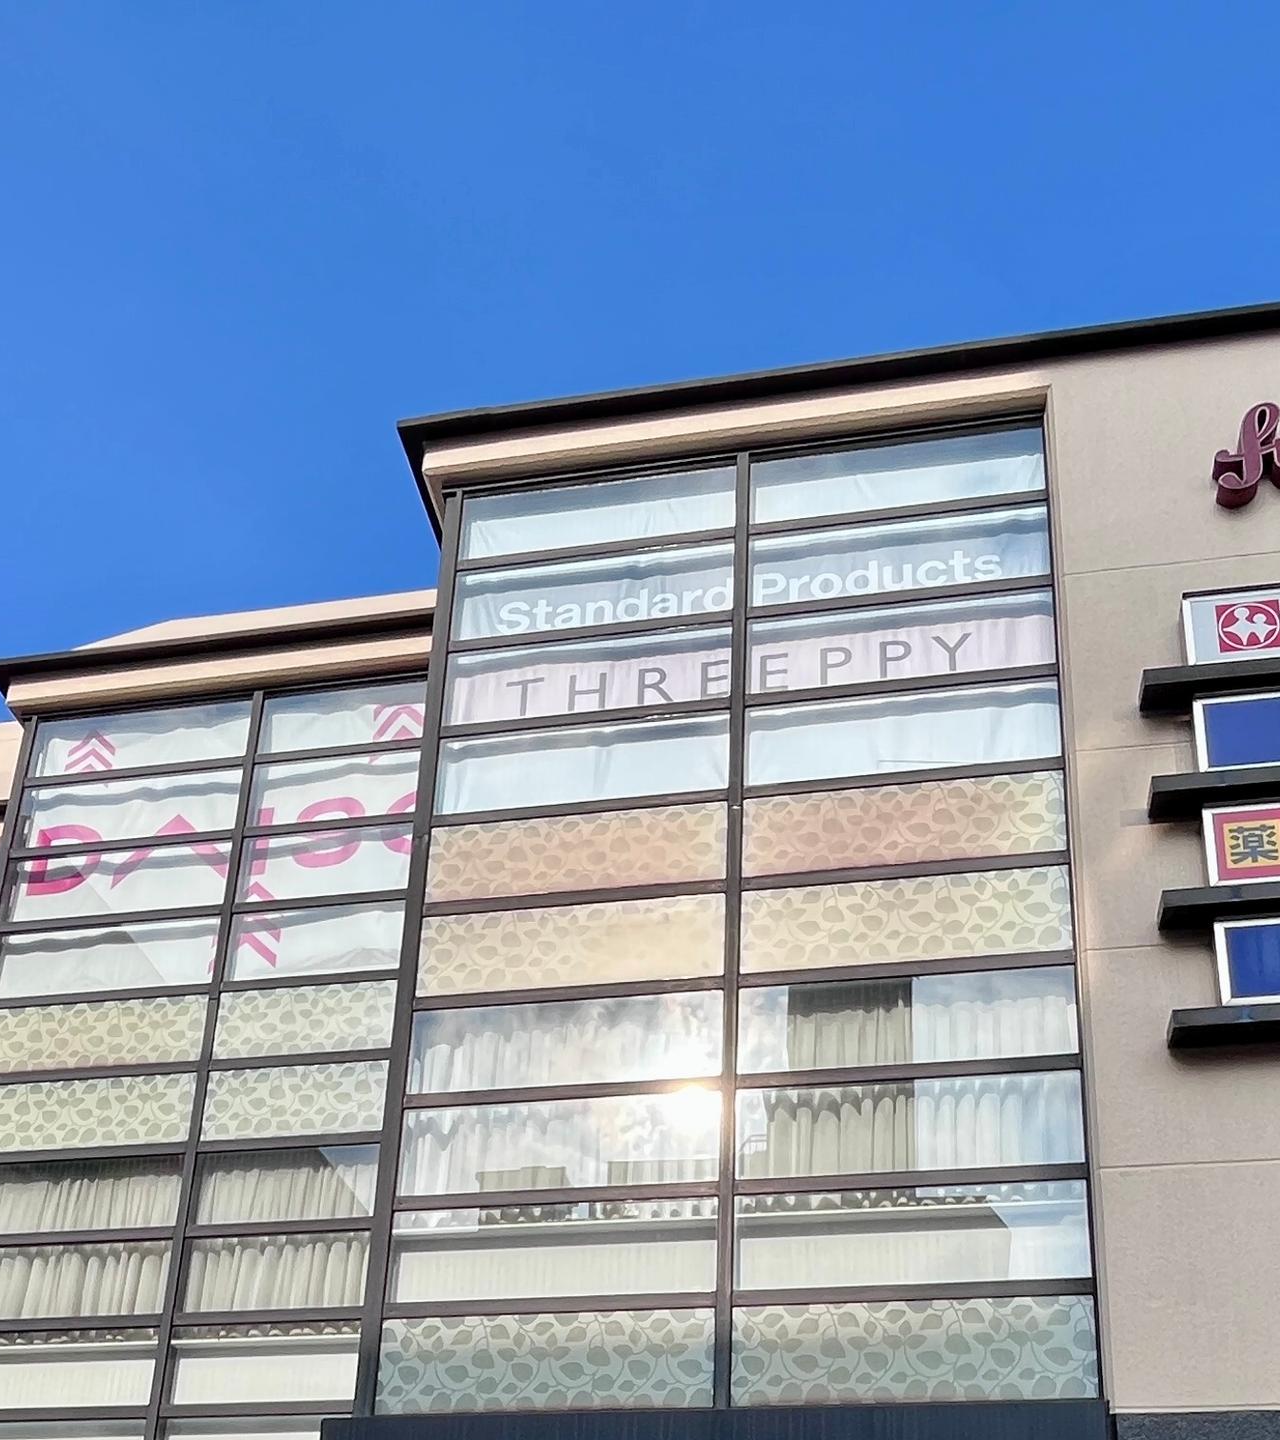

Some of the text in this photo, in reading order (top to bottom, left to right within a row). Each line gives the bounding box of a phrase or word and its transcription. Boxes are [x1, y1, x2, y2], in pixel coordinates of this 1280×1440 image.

[496, 548, 1004, 636] Standard Products
[507, 632, 972, 717] THREEPPY
[1229, 823, 1278, 866] 薬
